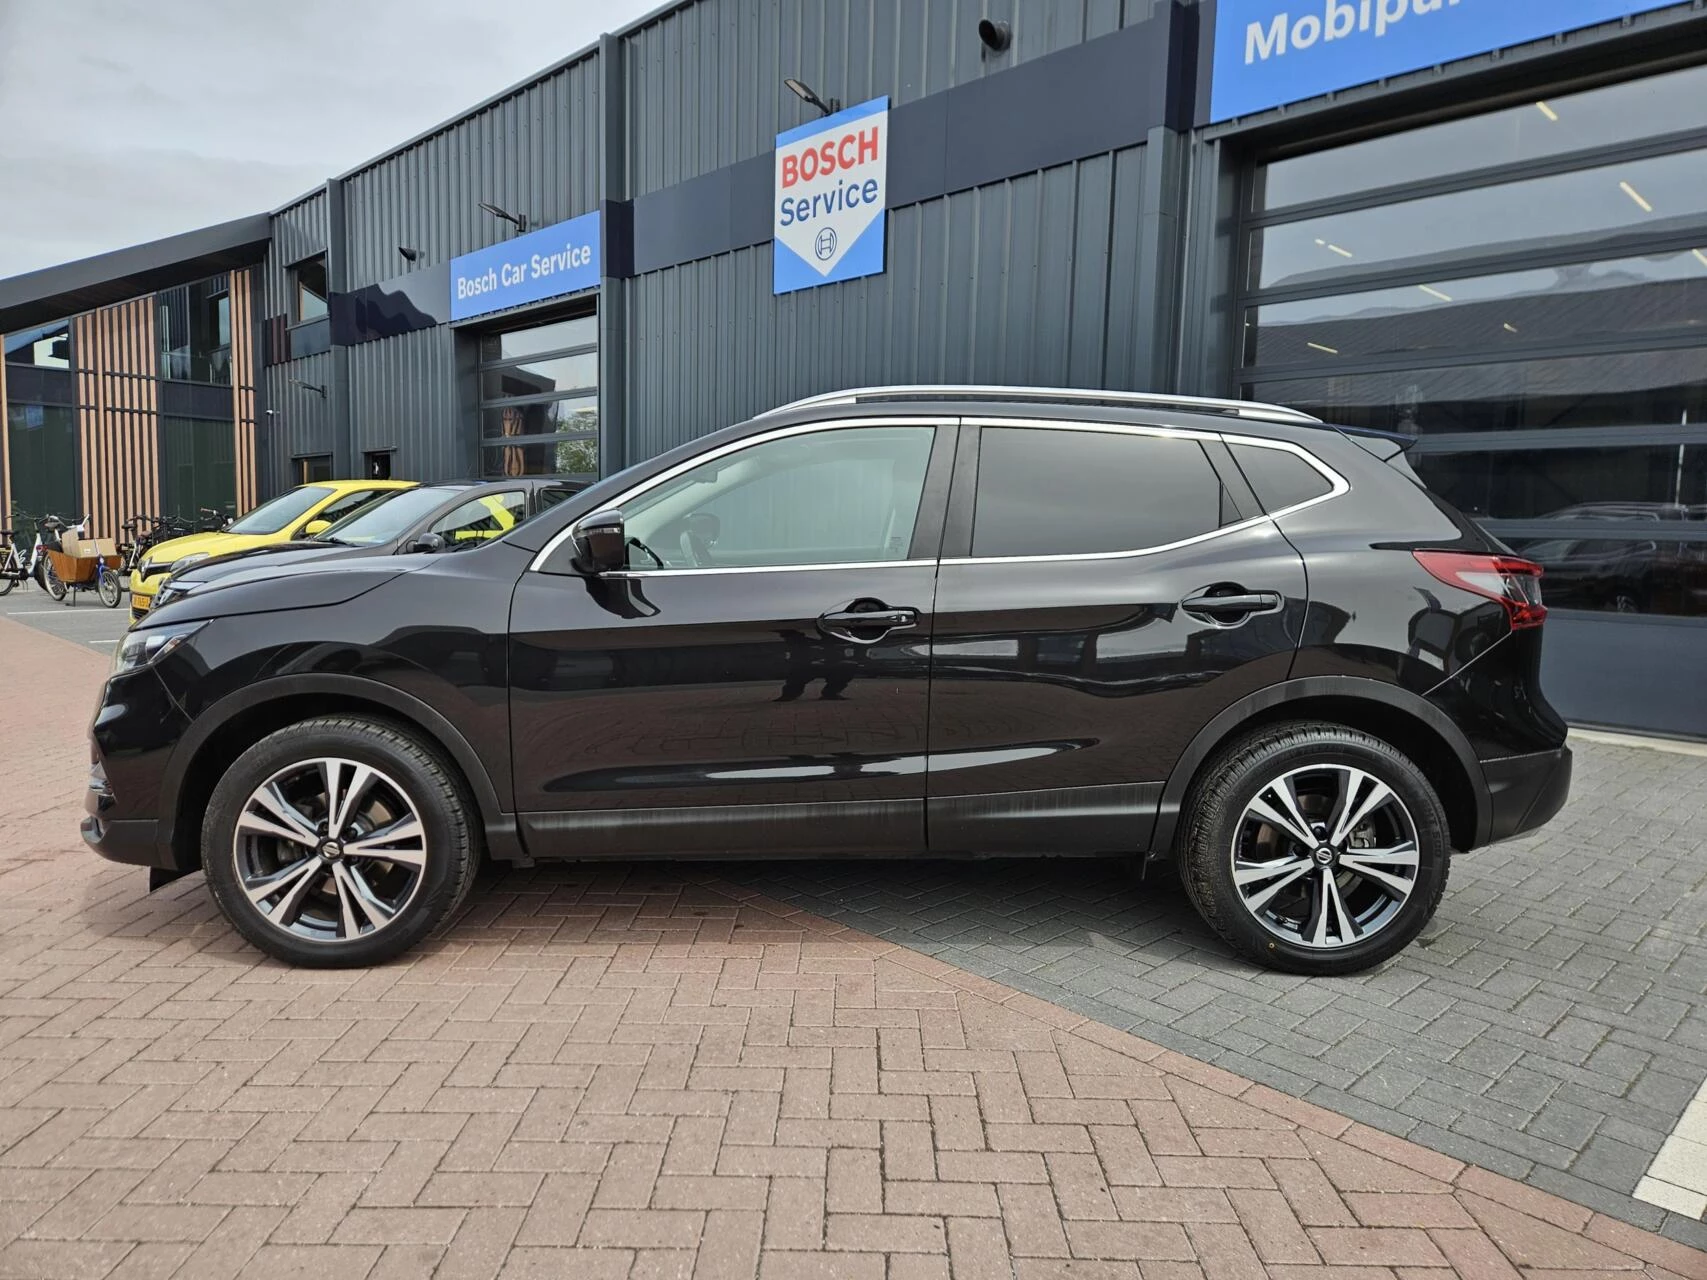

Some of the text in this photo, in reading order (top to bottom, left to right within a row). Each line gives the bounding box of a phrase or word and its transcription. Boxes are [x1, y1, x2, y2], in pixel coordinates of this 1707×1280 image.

[782, 126, 879, 189] BOSCH
[780, 178, 878, 227] Service
[457, 243, 591, 300] Bosch Car Service
